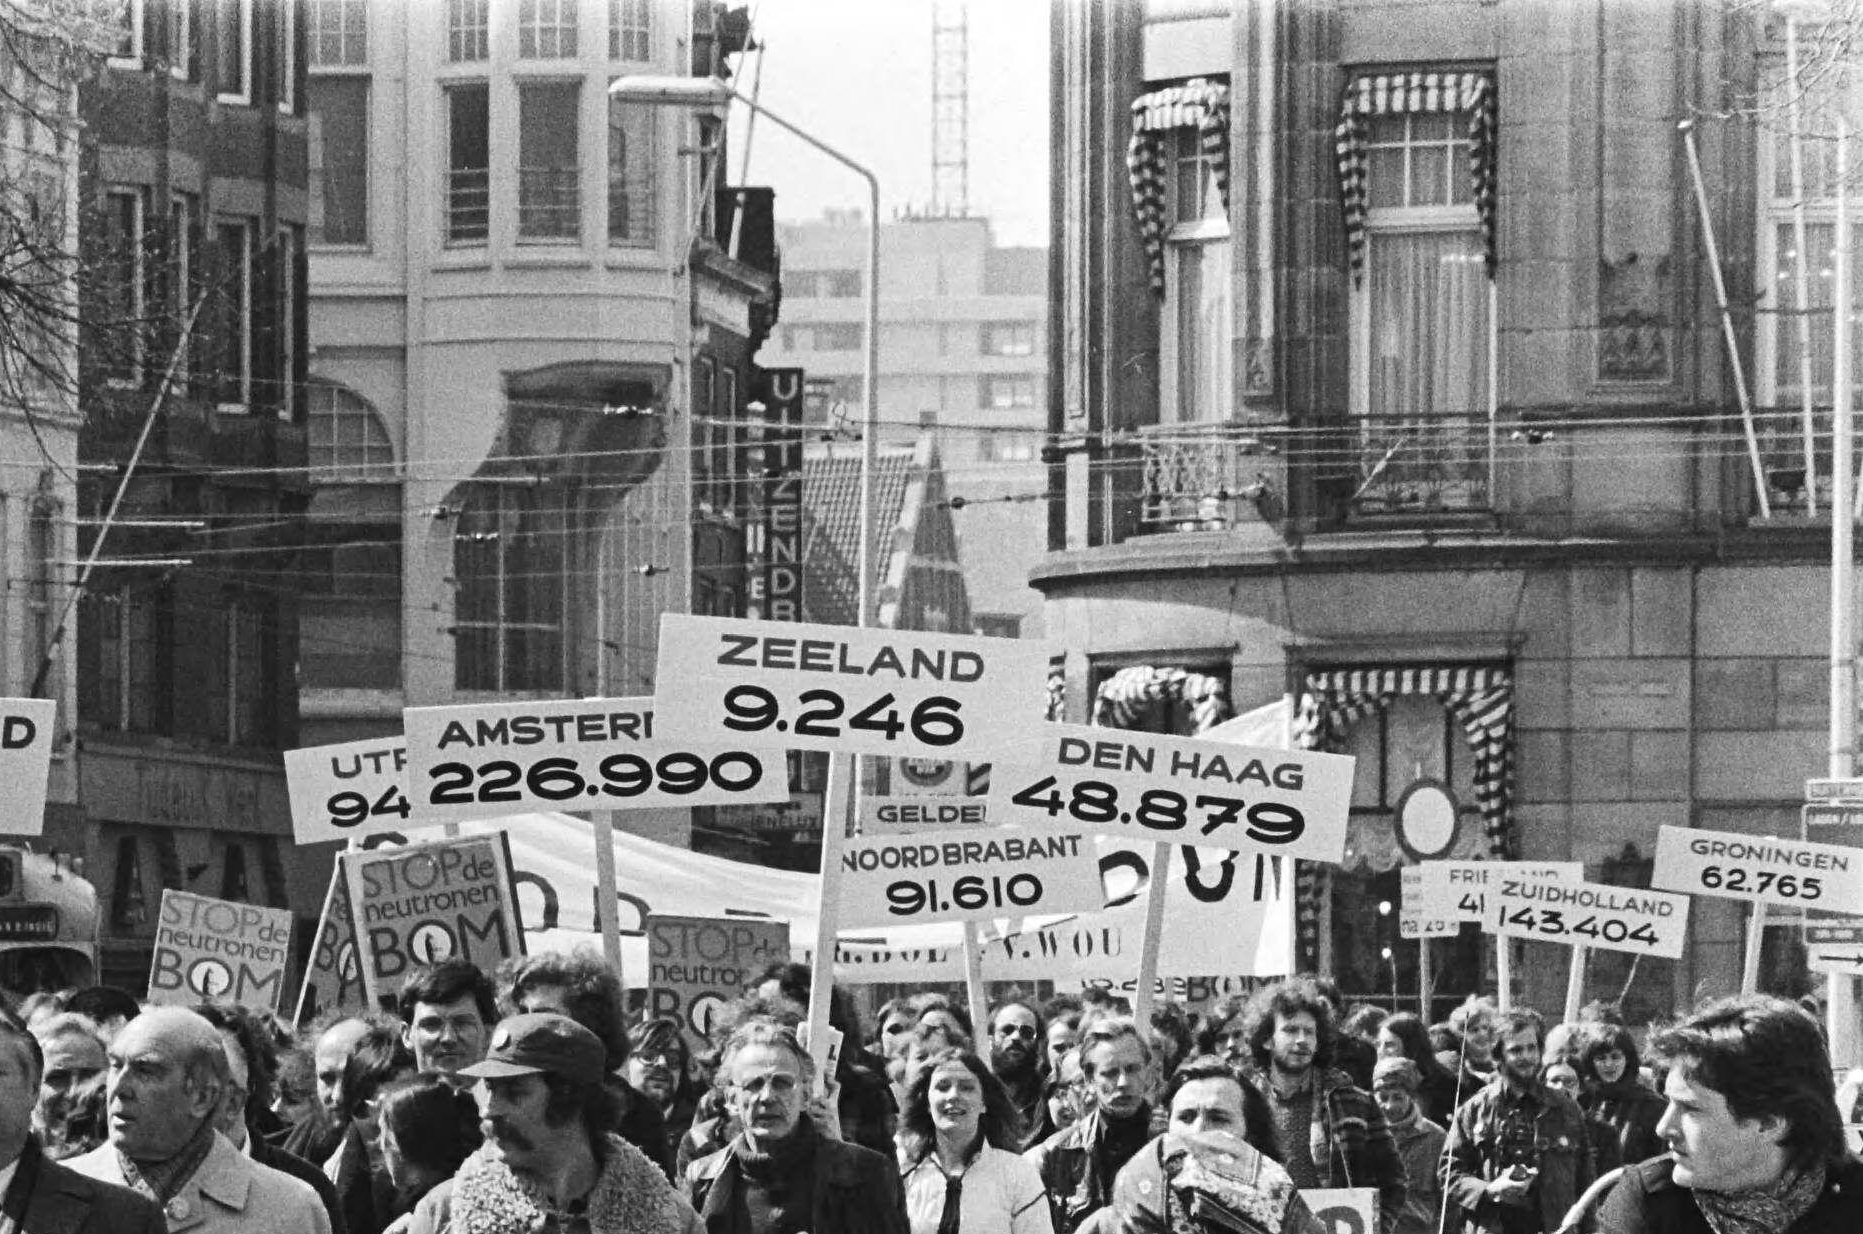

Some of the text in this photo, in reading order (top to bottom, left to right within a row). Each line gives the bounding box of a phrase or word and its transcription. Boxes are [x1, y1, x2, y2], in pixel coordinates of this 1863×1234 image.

[717, 633, 985, 683] ZEELAND
[723, 684, 964, 746] 9.246
[429, 751, 762, 804] 226.990
[1058, 737, 1305, 790] DEN HAAG
[1012, 775, 1305, 845] 48.879
[362, 849, 495, 897] STOP de
[1689, 838, 1850, 874] GRONINGEN
[364, 884, 501, 922] neutronen
[885, 873, 1044, 916] 91.610
[1501, 879, 1674, 918] ZUIDHOLLAND
[1701, 864, 1823, 901] 62.765
[162, 894, 288, 943] STOP de
[653, 922, 754, 962] STOP
[1498, 904, 1659, 947] 143.404
[159, 926, 285, 963] neutronen
[369, 909, 511, 978] BOM
[151, 946, 283, 1010] BOM
